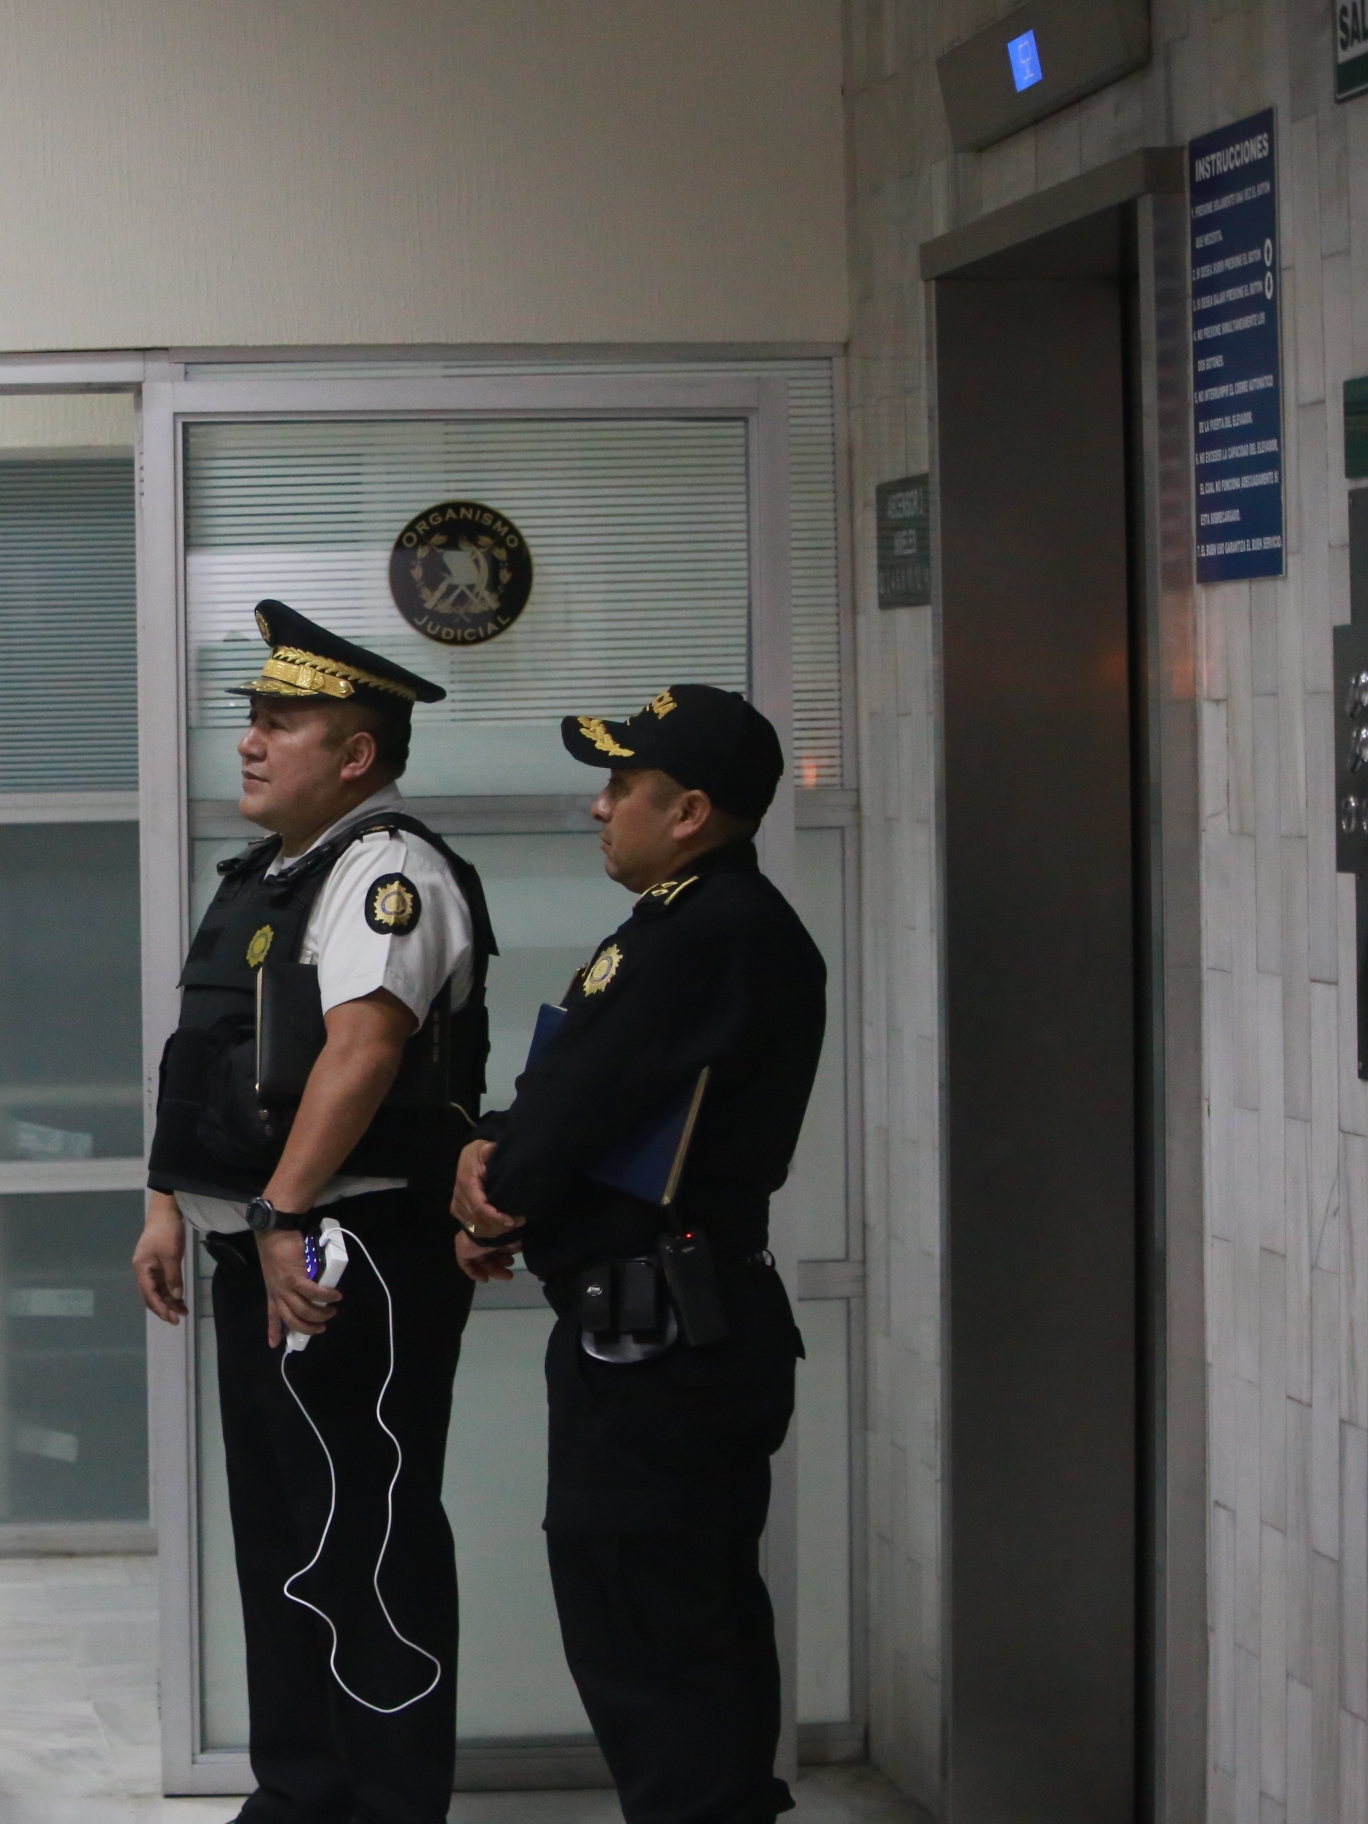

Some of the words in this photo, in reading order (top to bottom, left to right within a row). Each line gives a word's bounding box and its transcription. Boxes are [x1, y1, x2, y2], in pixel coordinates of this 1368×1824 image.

[1195, 132, 1268, 183] INSTRUCCIONES
[1225, 286, 1244, 302] PRESIONE
[1203, 324, 1221, 340] PRESIONE
[1198, 391, 1203, 403] NO
[1229, 384, 1234, 396] EL
[1234, 381, 1248, 395] CIERRE
[1198, 422, 1204, 434] DE
[1204, 420, 1209, 432] LA
[1209, 417, 1224, 431] PUERTA
[1199, 452, 1205, 465] NO
[1222, 448, 1227, 461] LA
[1227, 444, 1248, 460] CAPACIDAD
[1199, 483, 1204, 495] EL
[402, 507, 519, 548] ORGANISMO
[1200, 545, 1205, 556] EL
[1206, 544, 1216, 556] BUEN
[1216, 543, 1224, 555] USO
[1225, 540, 1245, 554] GARANTIZA
[1246, 540, 1251, 551] EL
[1251, 538, 1262, 551] BUEN
[414, 614, 510, 641] JUDICIAL
